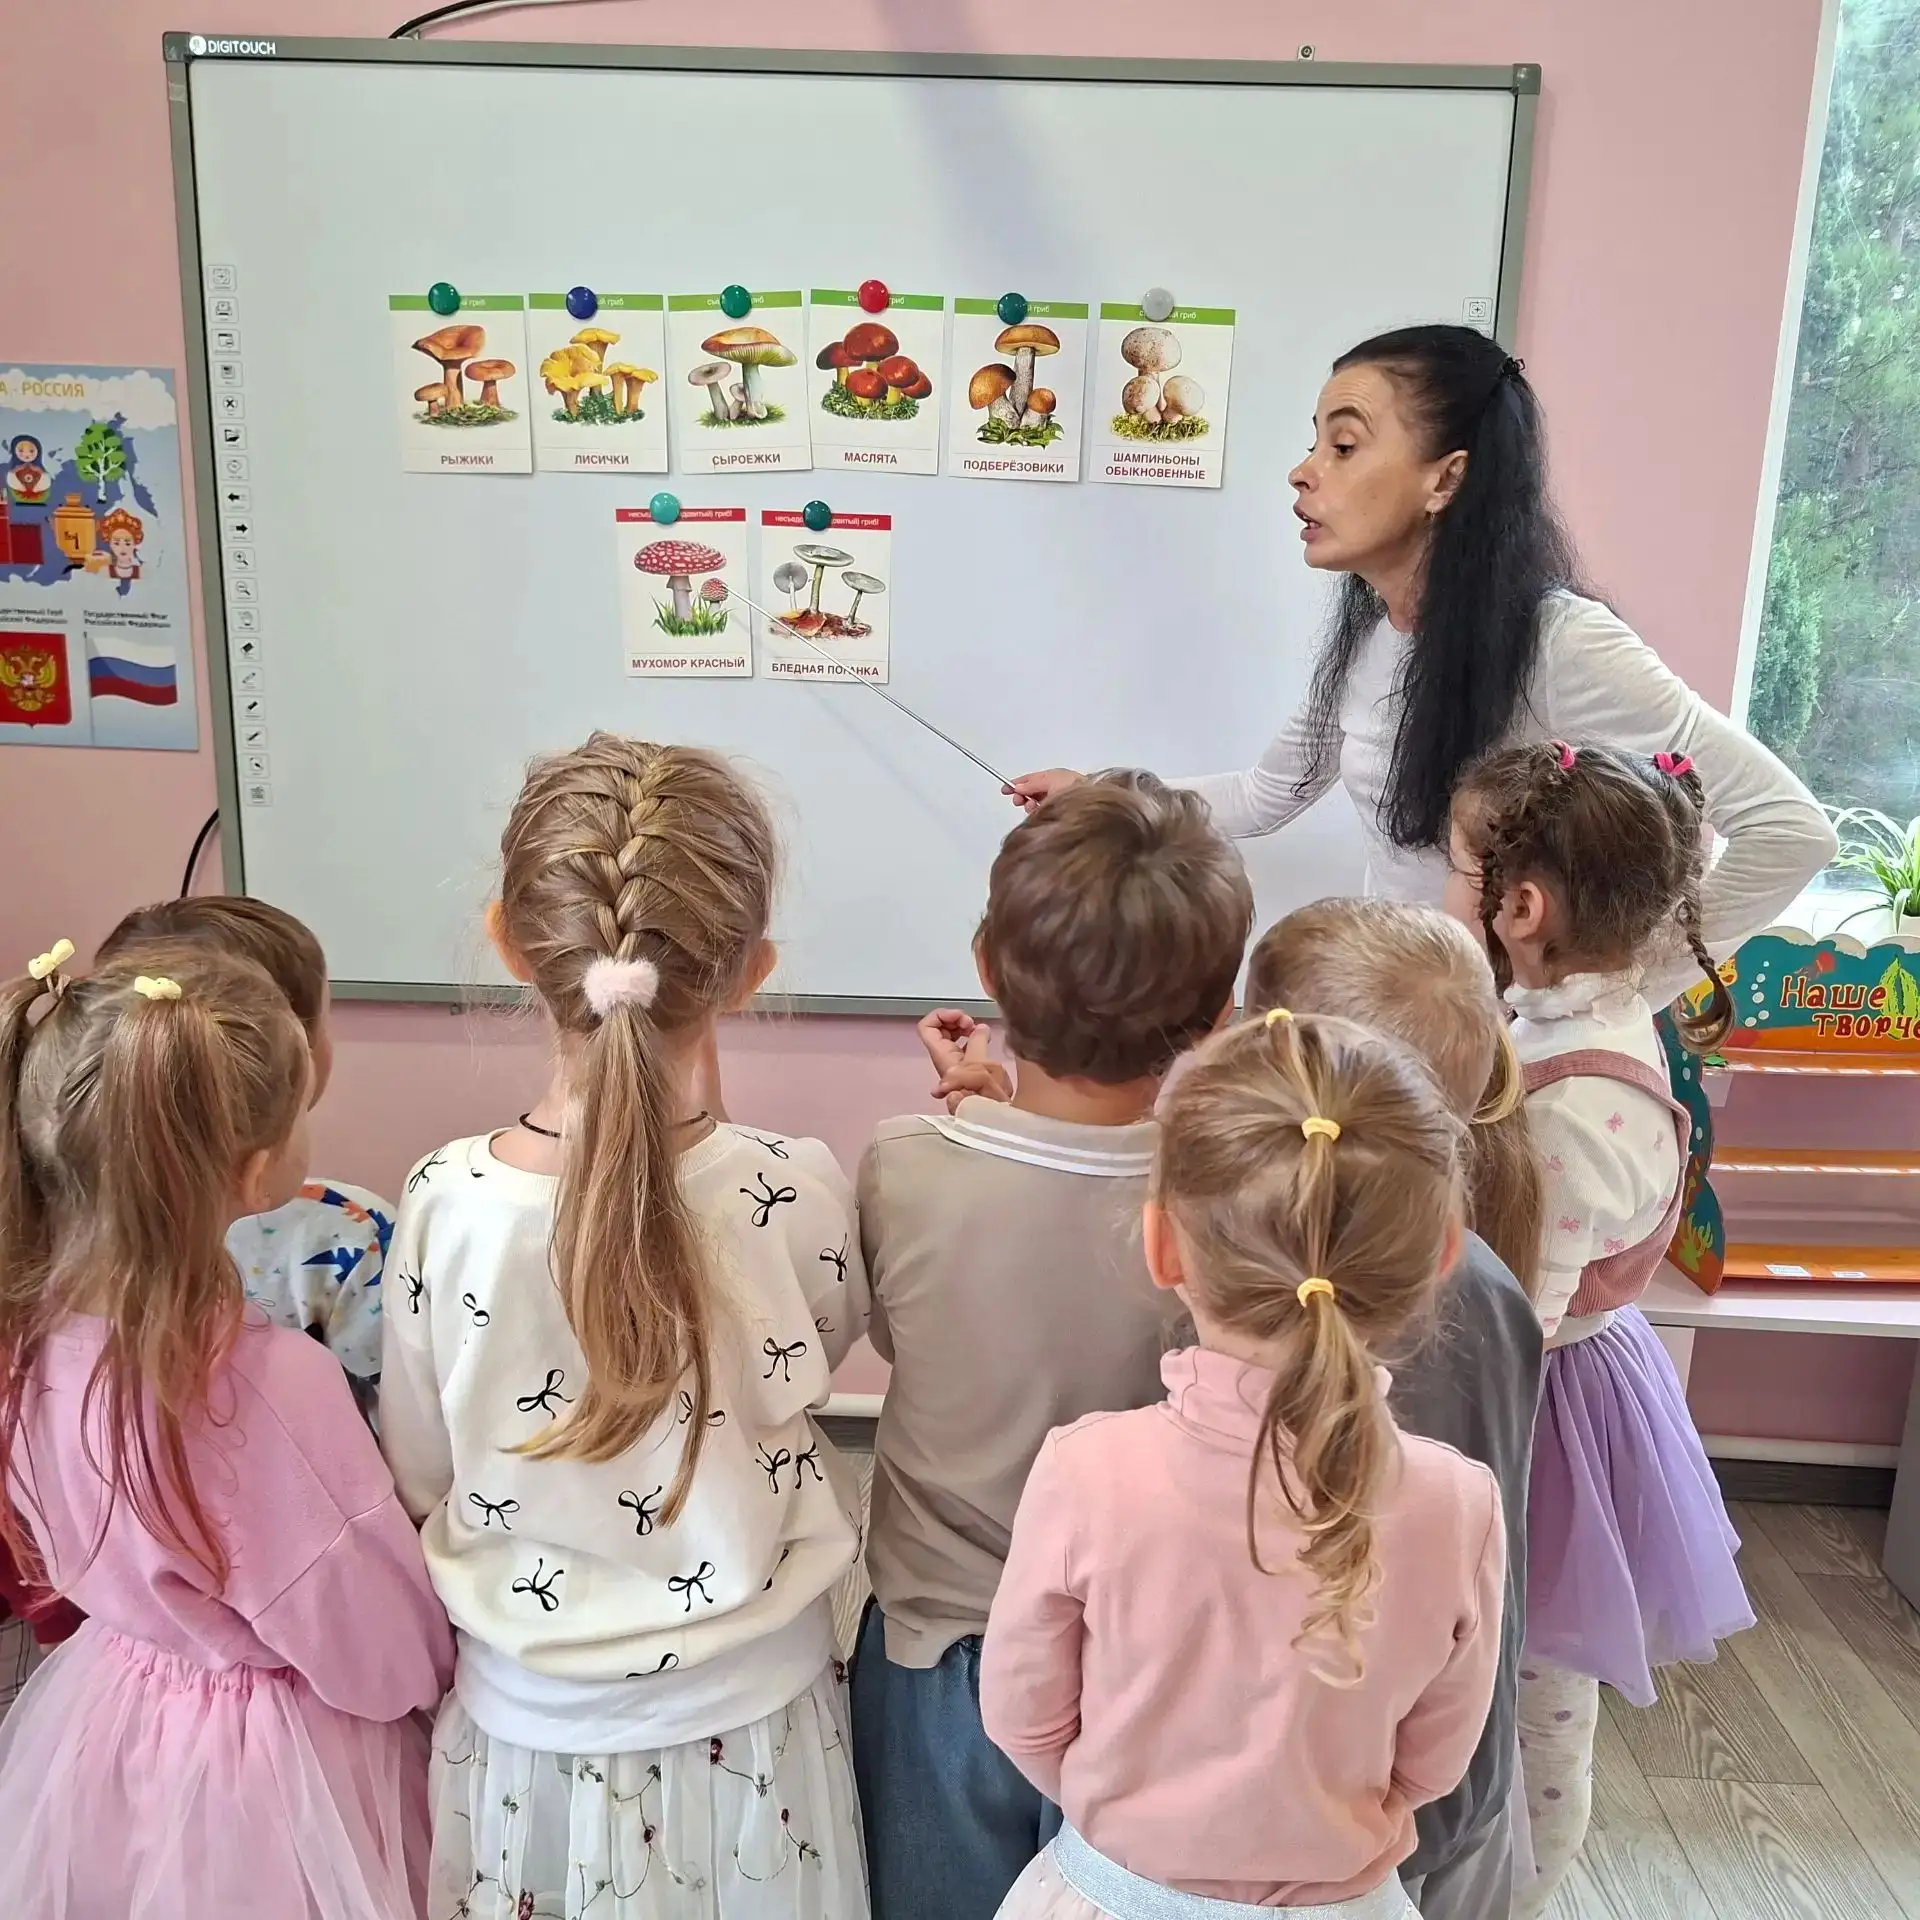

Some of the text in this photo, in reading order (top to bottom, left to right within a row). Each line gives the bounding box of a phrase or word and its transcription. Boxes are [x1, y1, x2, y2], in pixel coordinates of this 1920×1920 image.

[207, 39, 276, 55] DIGITOUCH
[1033, 305, 1050, 313] гриб
[1179, 312, 1197, 320] гриб
[22, 382, 85, 398] РОССИЯ
[440, 454, 494, 466] РЫЖИКИ
[574, 454, 630, 466] ЛИСИЧКИ
[712, 453, 781, 466] СЫРОЕЖКИ
[844, 451, 898, 465] МАСЛЯТА
[1113, 452, 1201, 467] ШАМПИНЬОНЫ
[963, 458, 1065, 474] ПОДБЕРЁЗОВИКИ
[1105, 466, 1206, 480] ОБЫКНОВЕННЫЕ
[632, 657, 745, 669] МУХОМОР КРАСНЫЙ
[772, 663, 824, 675] БЛЕДНАЯ
[1780, 975, 1888, 1011] Наше
